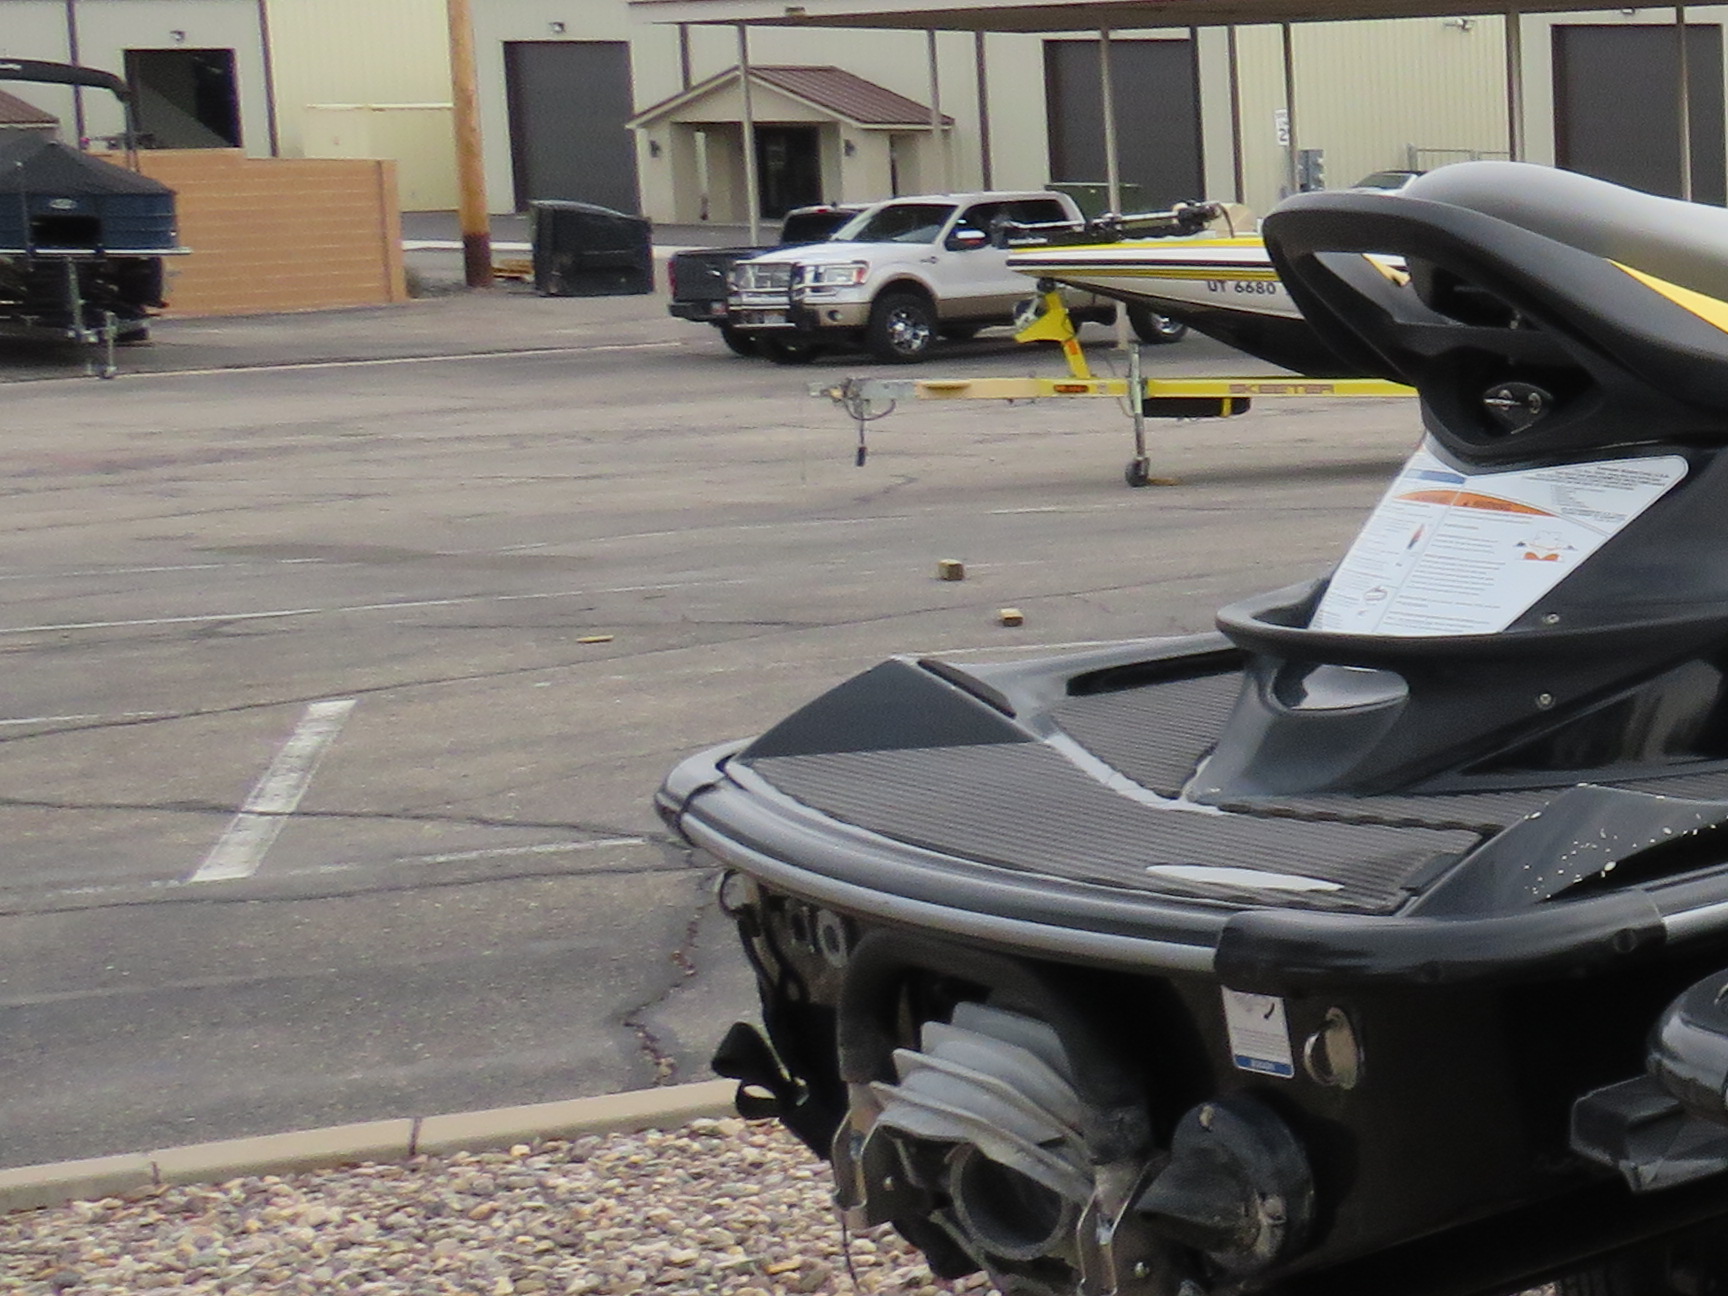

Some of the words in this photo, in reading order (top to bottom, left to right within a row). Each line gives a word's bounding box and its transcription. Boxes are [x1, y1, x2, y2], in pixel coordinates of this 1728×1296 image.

[1207, 281, 1226, 293] UT
[1234, 282, 1277, 295] 6680
[1229, 383, 1335, 394] SKEETER
